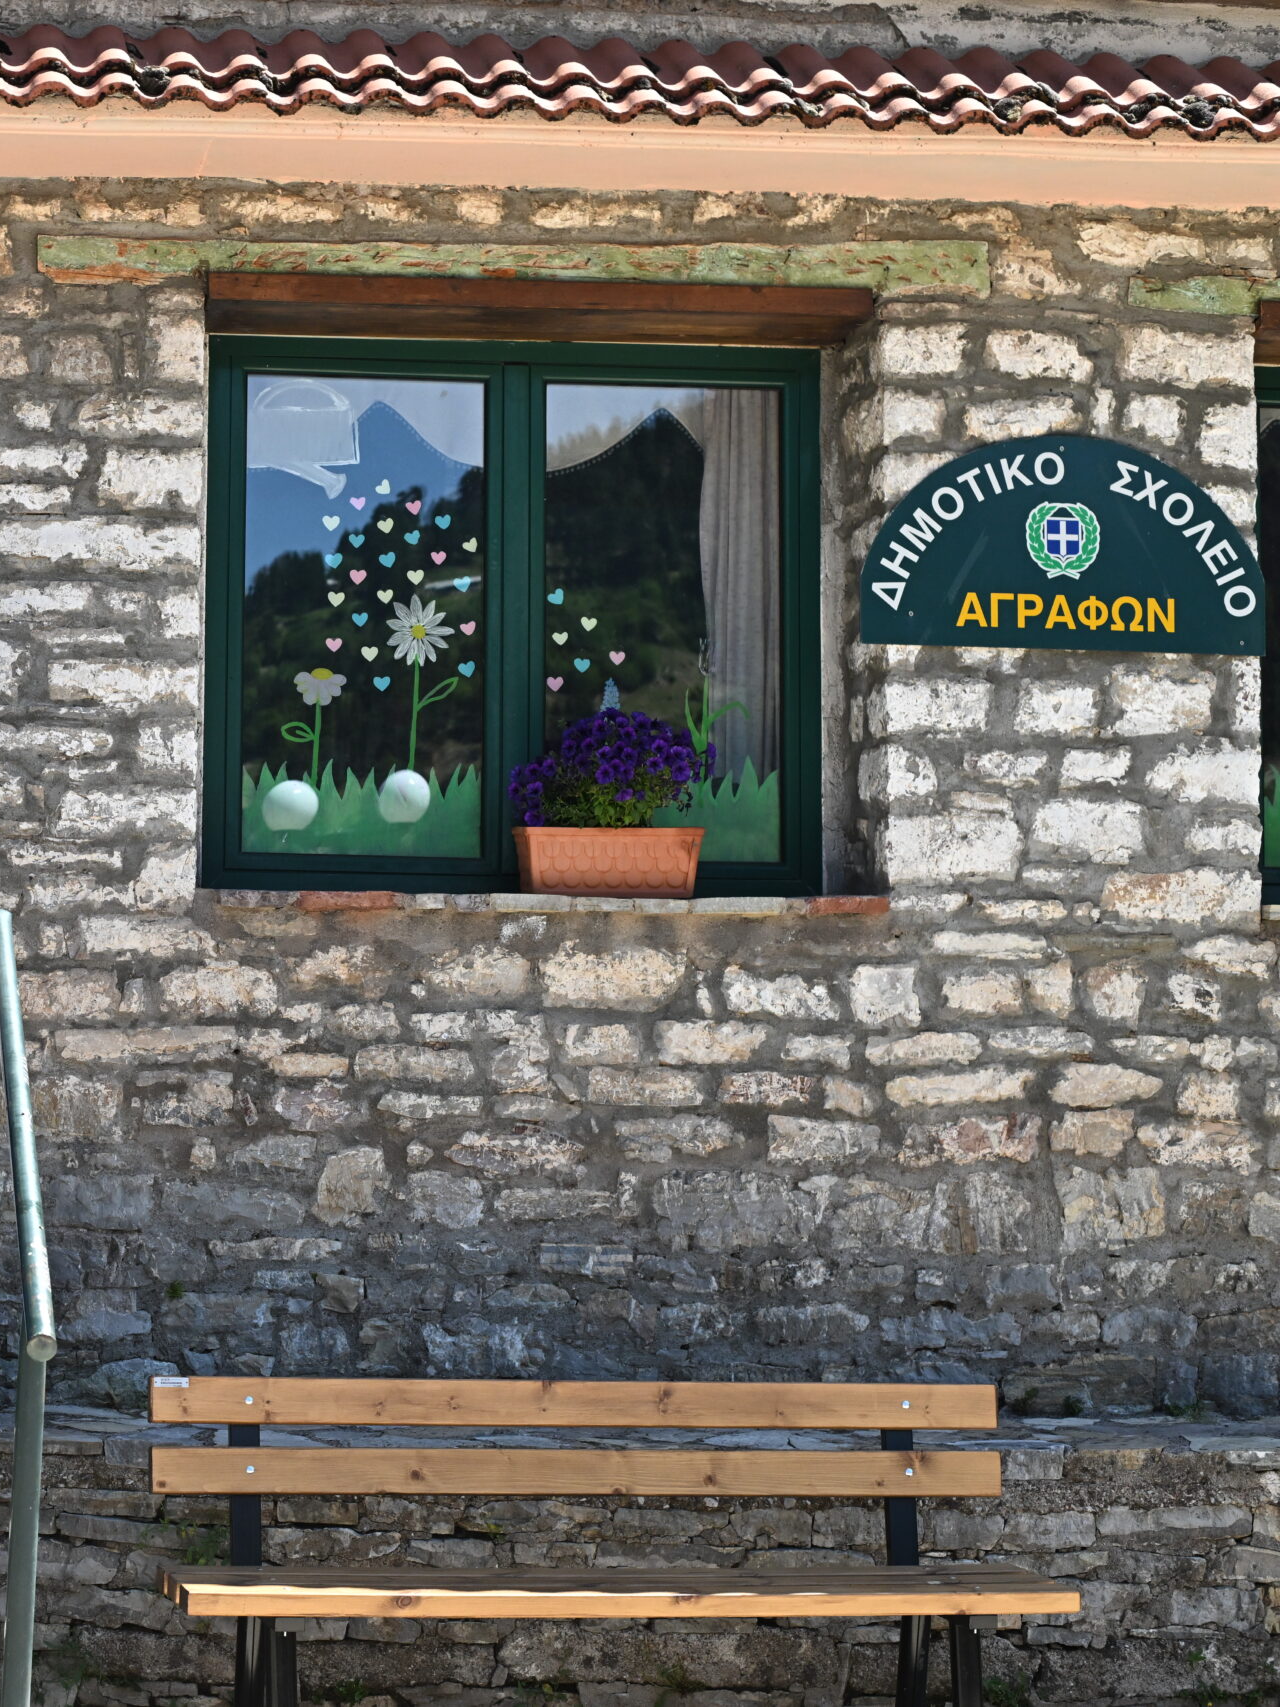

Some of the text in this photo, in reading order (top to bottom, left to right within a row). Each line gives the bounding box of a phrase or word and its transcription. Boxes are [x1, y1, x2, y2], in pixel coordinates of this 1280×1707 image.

[872, 451, 1257, 618] ΔΗΜΟΤΙΚΟ ΣΧΟΛΕΙΟ
[956, 592, 1176, 633] ΑΓΡΑΦΩΝ
